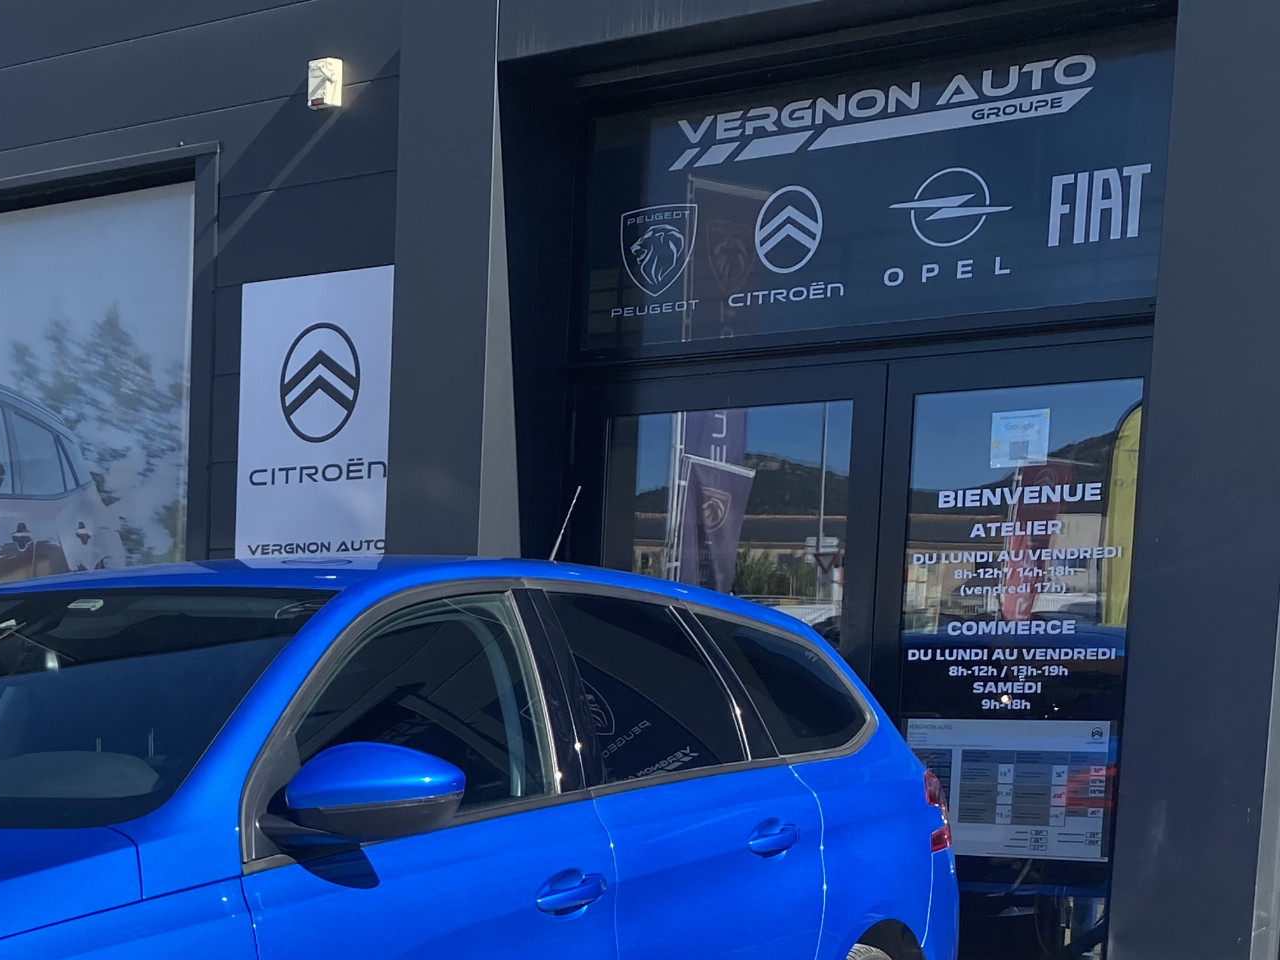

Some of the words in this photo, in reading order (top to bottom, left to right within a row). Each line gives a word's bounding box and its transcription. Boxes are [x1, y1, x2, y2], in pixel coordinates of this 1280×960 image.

[677, 81, 921, 143] VERGNON
[935, 53, 1096, 105] AUTO
[970, 95, 1064, 121] GROUPE
[1047, 163, 1152, 247] FIAT
[627, 210, 690, 226] PEUGEOT
[883, 255, 1011, 287] OPEL
[611, 299, 700, 318] PEUGEOT
[937, 482, 1102, 508] BIENVENUE
[970, 520, 1062, 538] ATELIER
[247, 541, 331, 556] VERGNON
[336, 538, 385, 553] AUTO
[912, 552, 937, 565] DU
[940, 551, 993, 563] LUNDI
[997, 549, 1023, 562] AU
[1026, 546, 1122, 561] VENDREDI
[954, 567, 1002, 580] 8h-12h
[1016, 566, 1075, 578] 14h-18h
[960, 582, 1031, 597] (vendredi
[1034, 582, 1067, 594] 17h)
[947, 619, 1076, 636] COMMERCE
[908, 649, 932, 661] DU
[935, 648, 988, 661] LUNDI
[992, 648, 1018, 661] AU
[1022, 648, 1116, 660] VENDREDI
[948, 665, 998, 677] 8h-12h
[1010, 665, 1068, 677] 13h-19h
[973, 681, 1042, 694] SAMEDI
[981, 698, 1031, 710] 9h-18h
